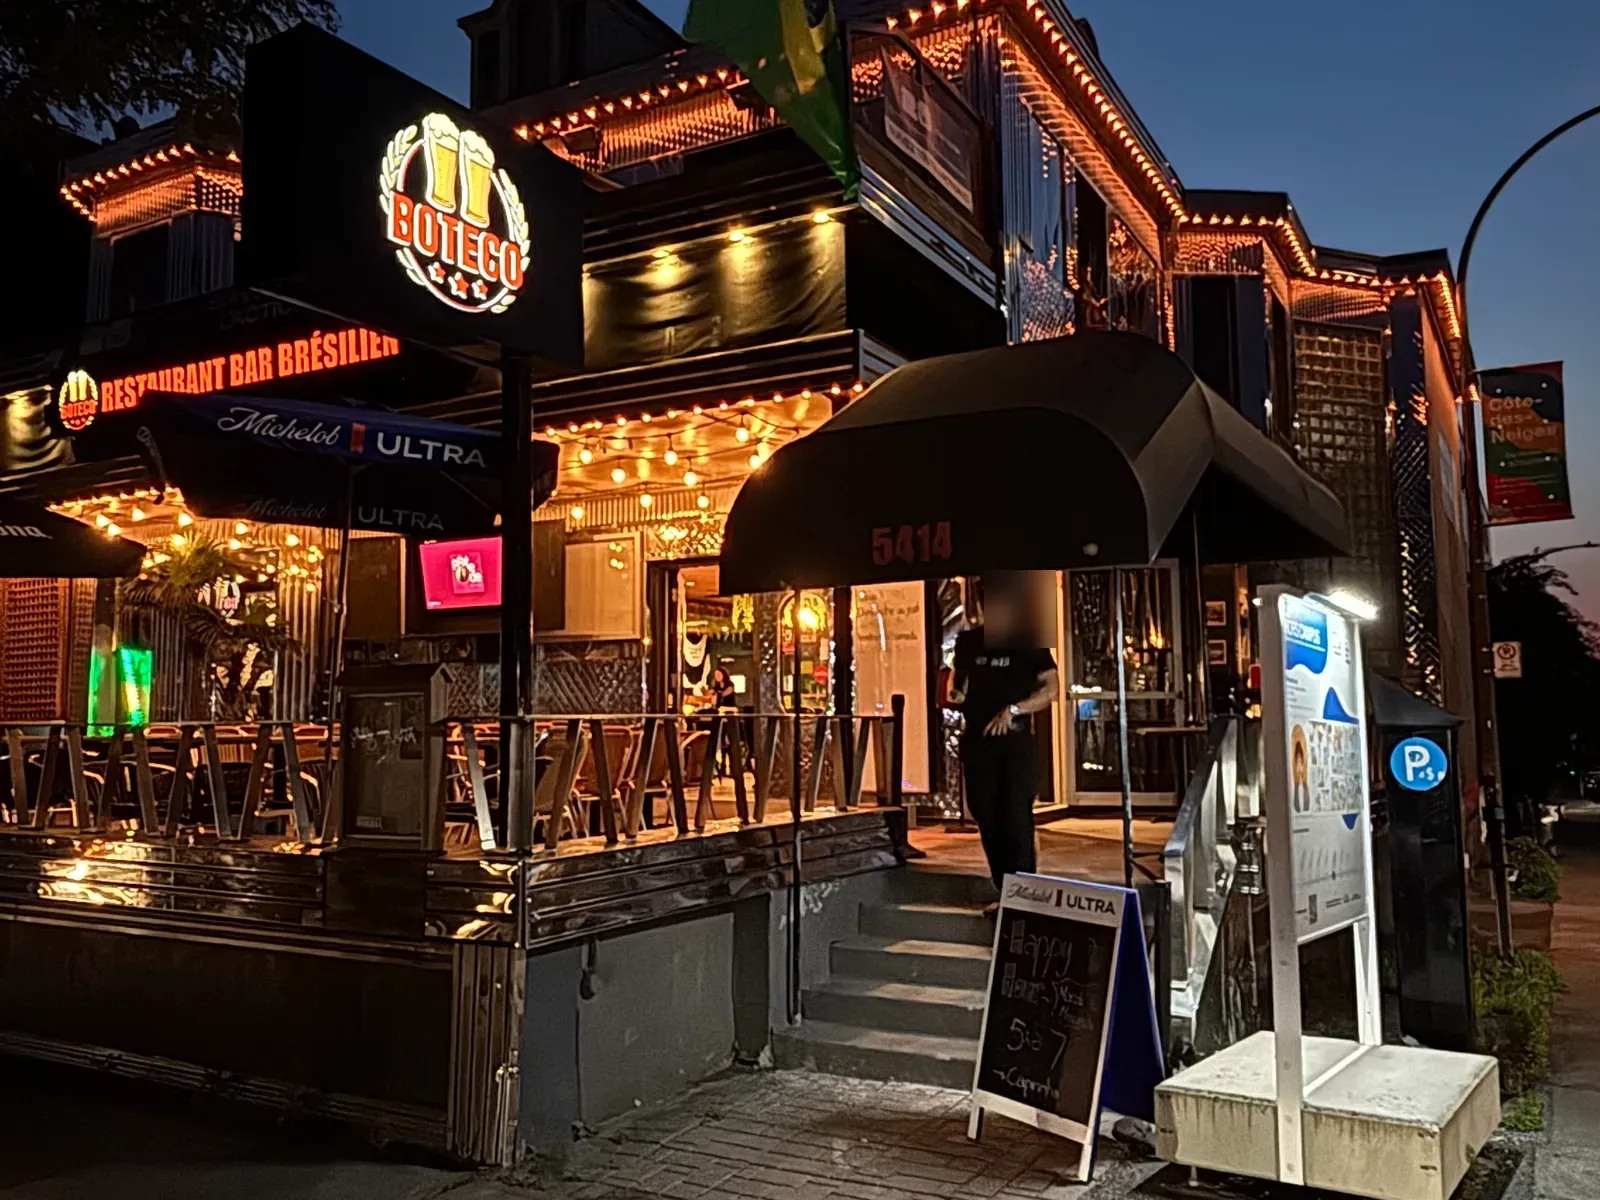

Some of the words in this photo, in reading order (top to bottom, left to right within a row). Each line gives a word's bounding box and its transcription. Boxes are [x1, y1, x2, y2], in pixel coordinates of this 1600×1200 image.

[387, 191, 524, 291] BOTECO
[101, 357, 225, 413] RESTAURANT
[230, 346, 273, 387] BAR
[278, 328, 400, 378] BRÉSILIEN
[60, 399, 97, 420] BOTECO
[217, 406, 342, 446] Michelob
[376, 430, 489, 470] ULTRA
[356, 504, 445, 532] ULTRA
[872, 521, 953, 567] 5414
[1066, 894, 1116, 916] ULTRA
[1006, 1017, 1027, 1051] 5
[1050, 1028, 1068, 1071] 7
